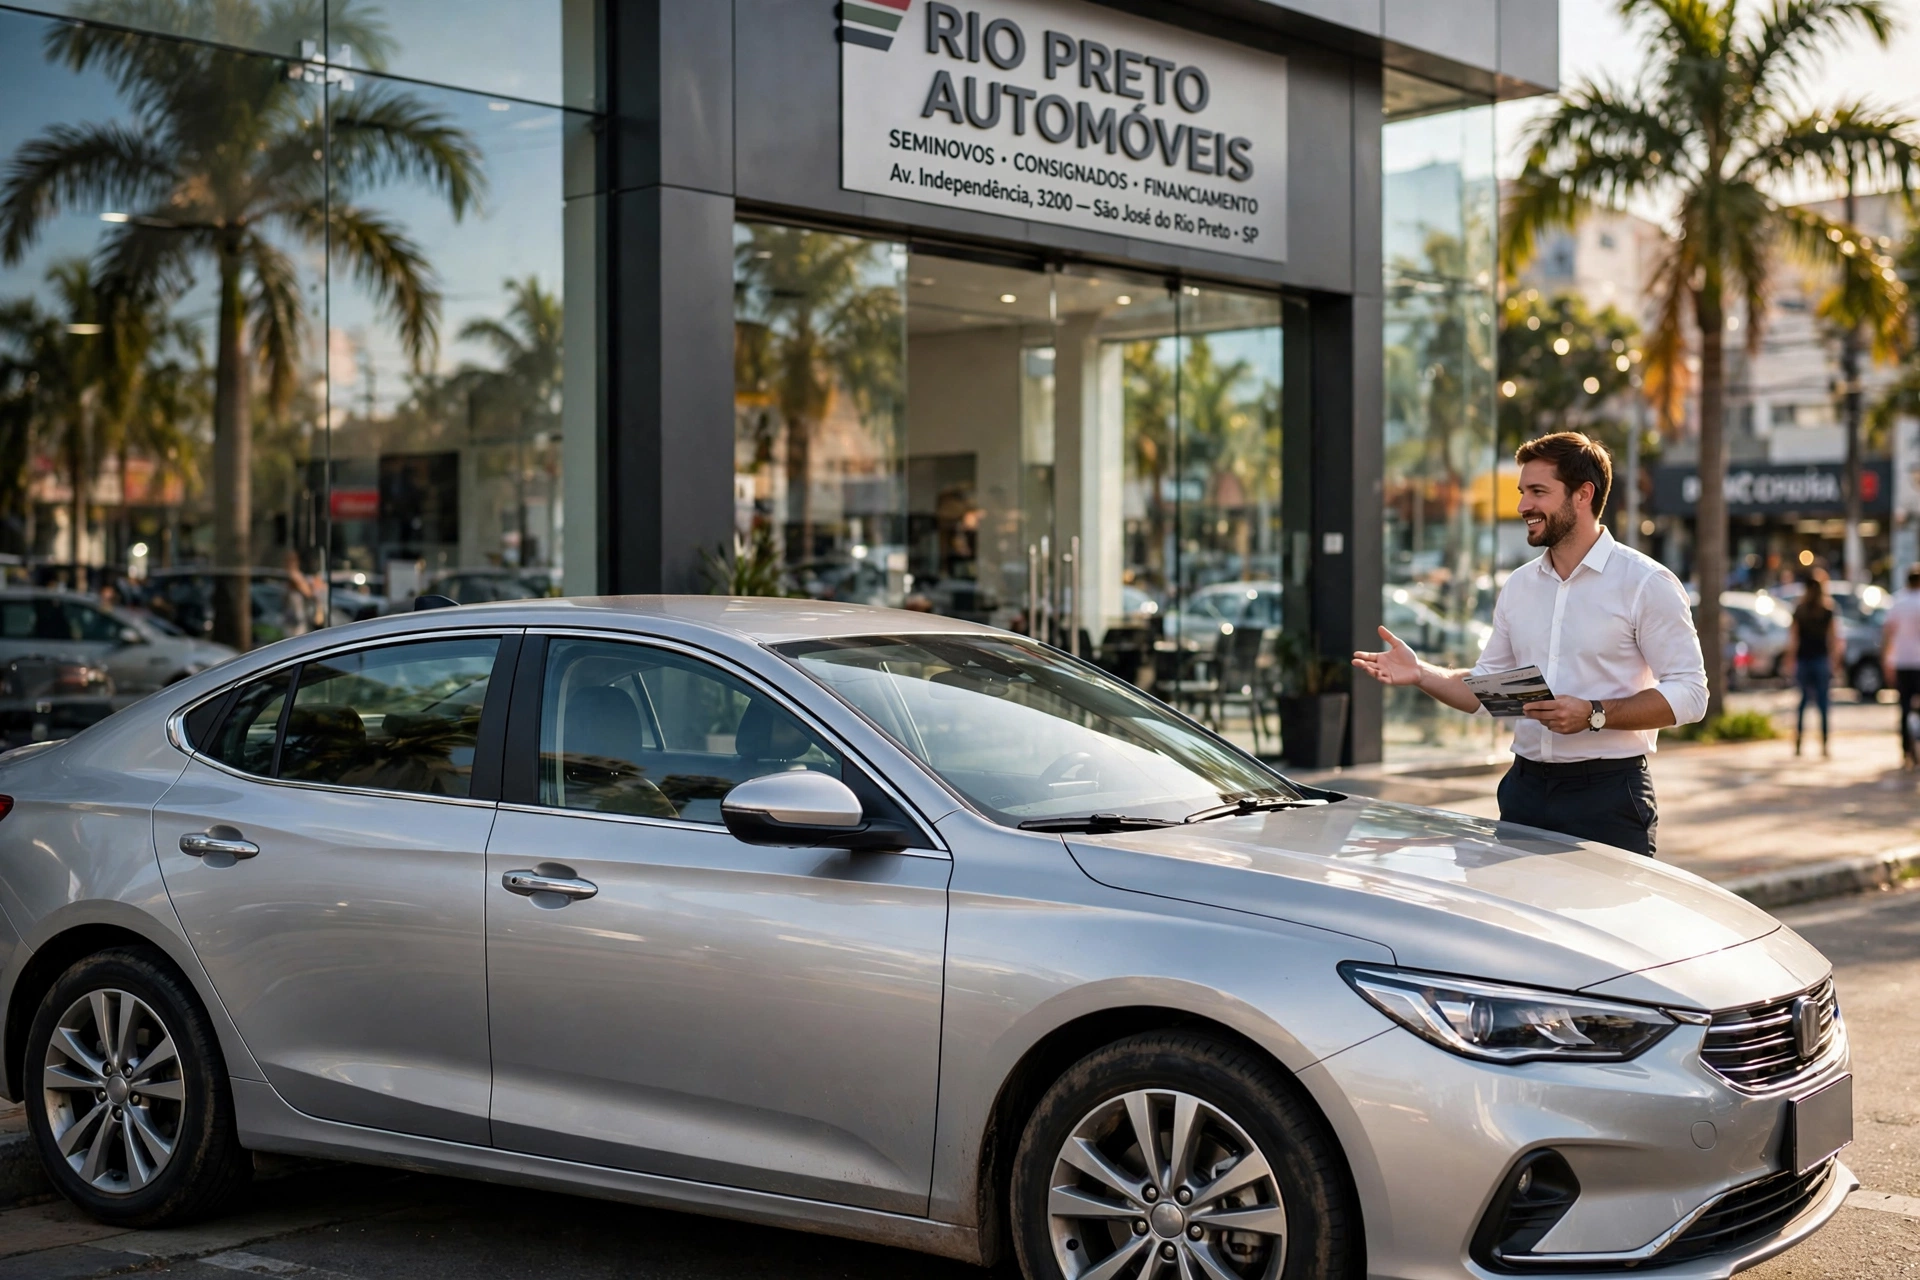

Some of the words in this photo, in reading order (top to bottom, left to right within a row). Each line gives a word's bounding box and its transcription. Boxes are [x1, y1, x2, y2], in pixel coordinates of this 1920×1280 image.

[926, 0, 1026, 71] RIO
[1044, 30, 1210, 114] PRETO
[889, 129, 995, 166] SEMINOVOS
[1014, 152, 1128, 190] CONSIGNADOS
[1144, 178, 1258, 215] FINANCIAMENTO
[921, 70, 1254, 182] AUTOMÓVEIS
[890, 163, 915, 184] Av.
[919, 167, 1033, 208] Independência,
[1037, 189, 1073, 211] 3200
[1093, 199, 1119, 220] São
[1122, 204, 1151, 226] José
[1155, 210, 1171, 229] do
[1174, 213, 1195, 233] Rio
[1198, 217, 1231, 240] Preto
[1242, 226, 1259, 243] SP
